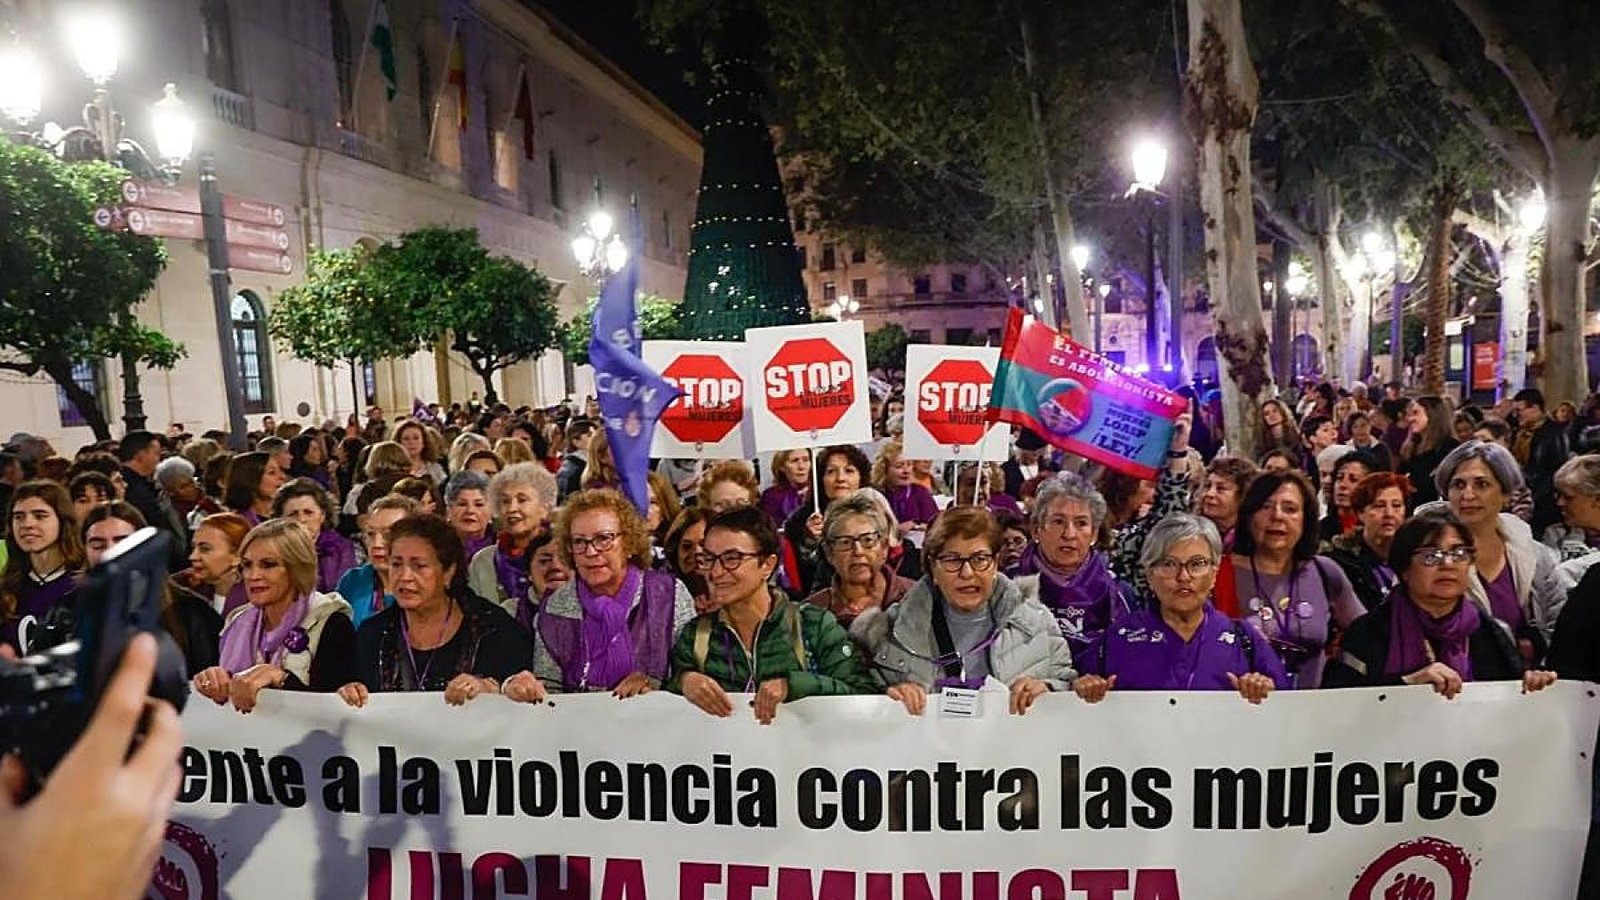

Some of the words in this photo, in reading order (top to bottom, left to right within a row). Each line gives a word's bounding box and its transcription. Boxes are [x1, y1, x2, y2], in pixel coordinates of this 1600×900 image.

[766, 360, 852, 398] STOP
[321, 754, 361, 813] a
[378, 747, 441, 815] la
[455, 748, 777, 828] violencia
[798, 762, 1039, 832] contra
[1061, 755, 1172, 830] las
[1193, 752, 1499, 833] mujeres
